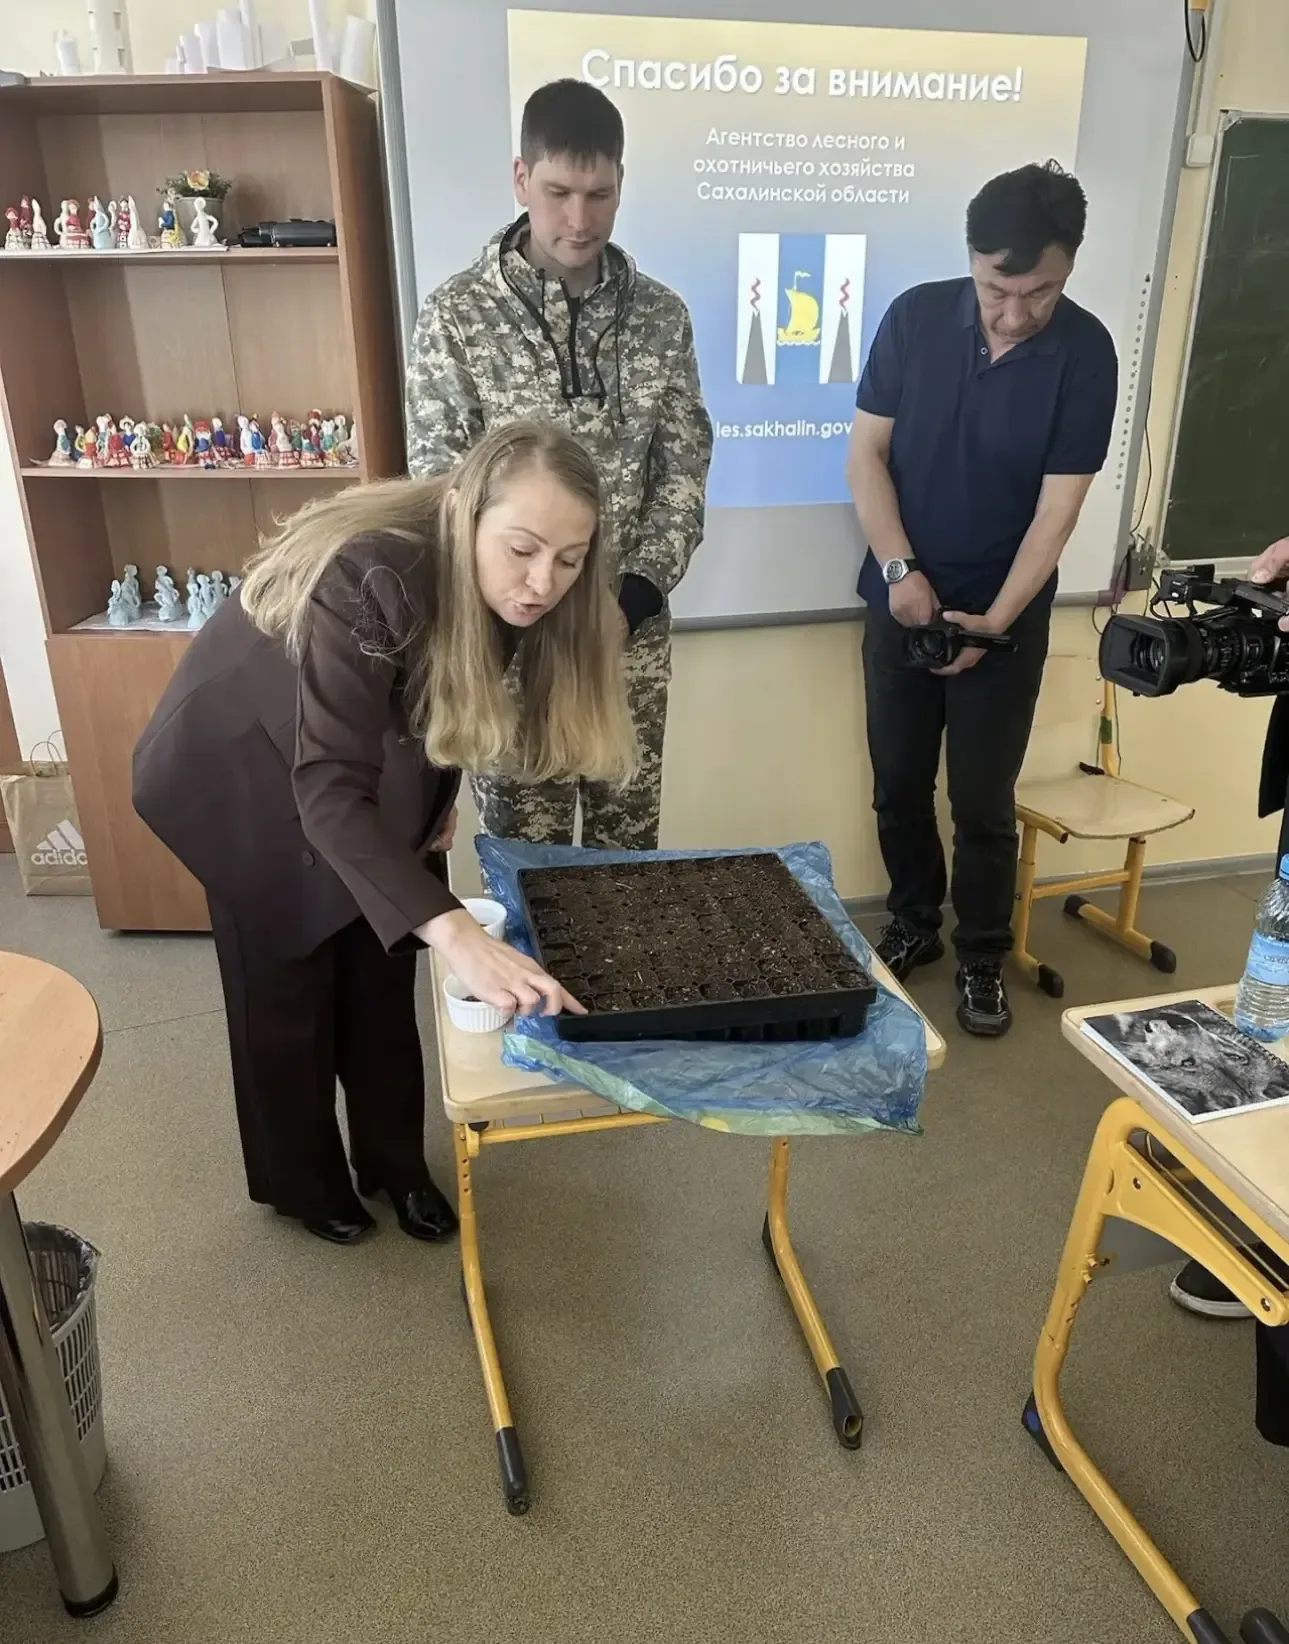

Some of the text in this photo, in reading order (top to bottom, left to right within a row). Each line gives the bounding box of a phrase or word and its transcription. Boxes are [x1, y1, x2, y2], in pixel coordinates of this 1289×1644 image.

[582, 48, 1022, 102] Спасибо за внимание!
[706, 127, 905, 151] Агентство лесного и
[693, 156, 915, 177] охотничьего хозяйства
[696, 181, 910, 203] Сахалинской области
[31, 848, 88, 865] adida
